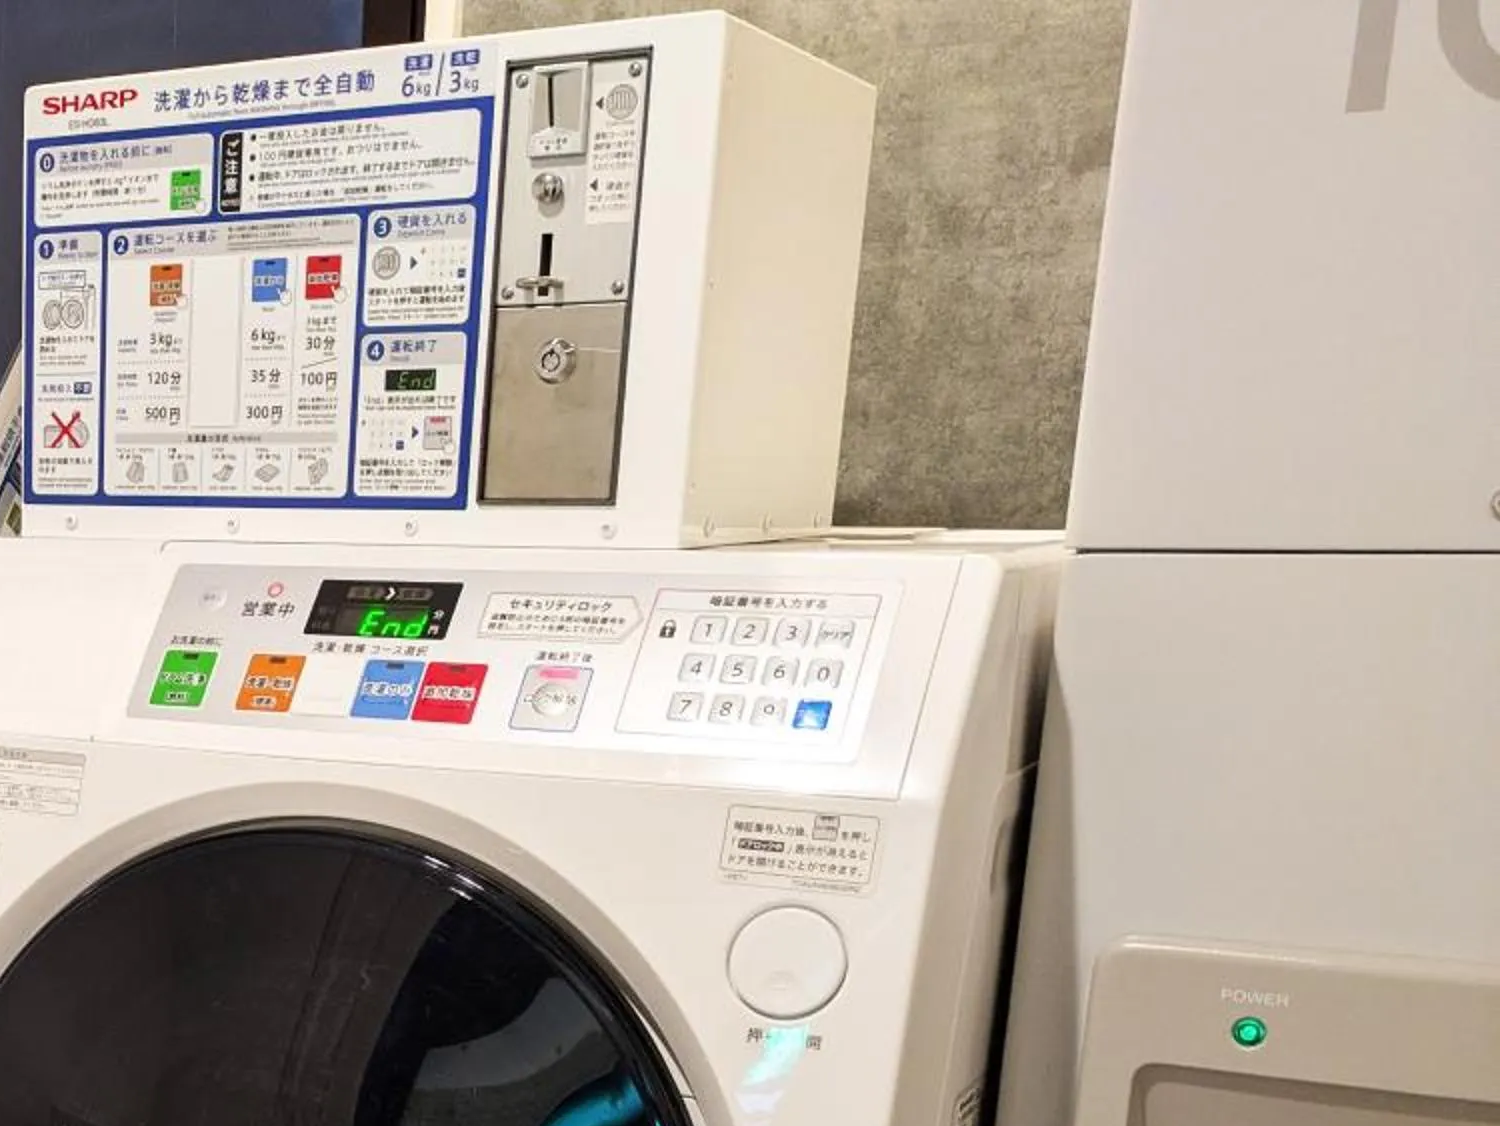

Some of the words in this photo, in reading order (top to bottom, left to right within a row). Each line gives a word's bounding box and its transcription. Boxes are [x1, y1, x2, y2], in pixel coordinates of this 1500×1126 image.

[153, 69, 375, 113] 洗濯から乾燥まで全自動
[42, 88, 138, 115] SHARP
[148, 371, 181, 385] 120分
[251, 369, 281, 383] 35分
[396, 371, 435, 391] End
[246, 405, 283, 419] 300円
[241, 601, 296, 618] 営業中
[509, 599, 613, 613] セキュリティロック
[709, 595, 829, 611] 暗証番号を入力する
[358, 608, 430, 638] End
[726, 853, 864, 878] ドアを開けることができます。
[1221, 987, 1290, 1009] POWER
